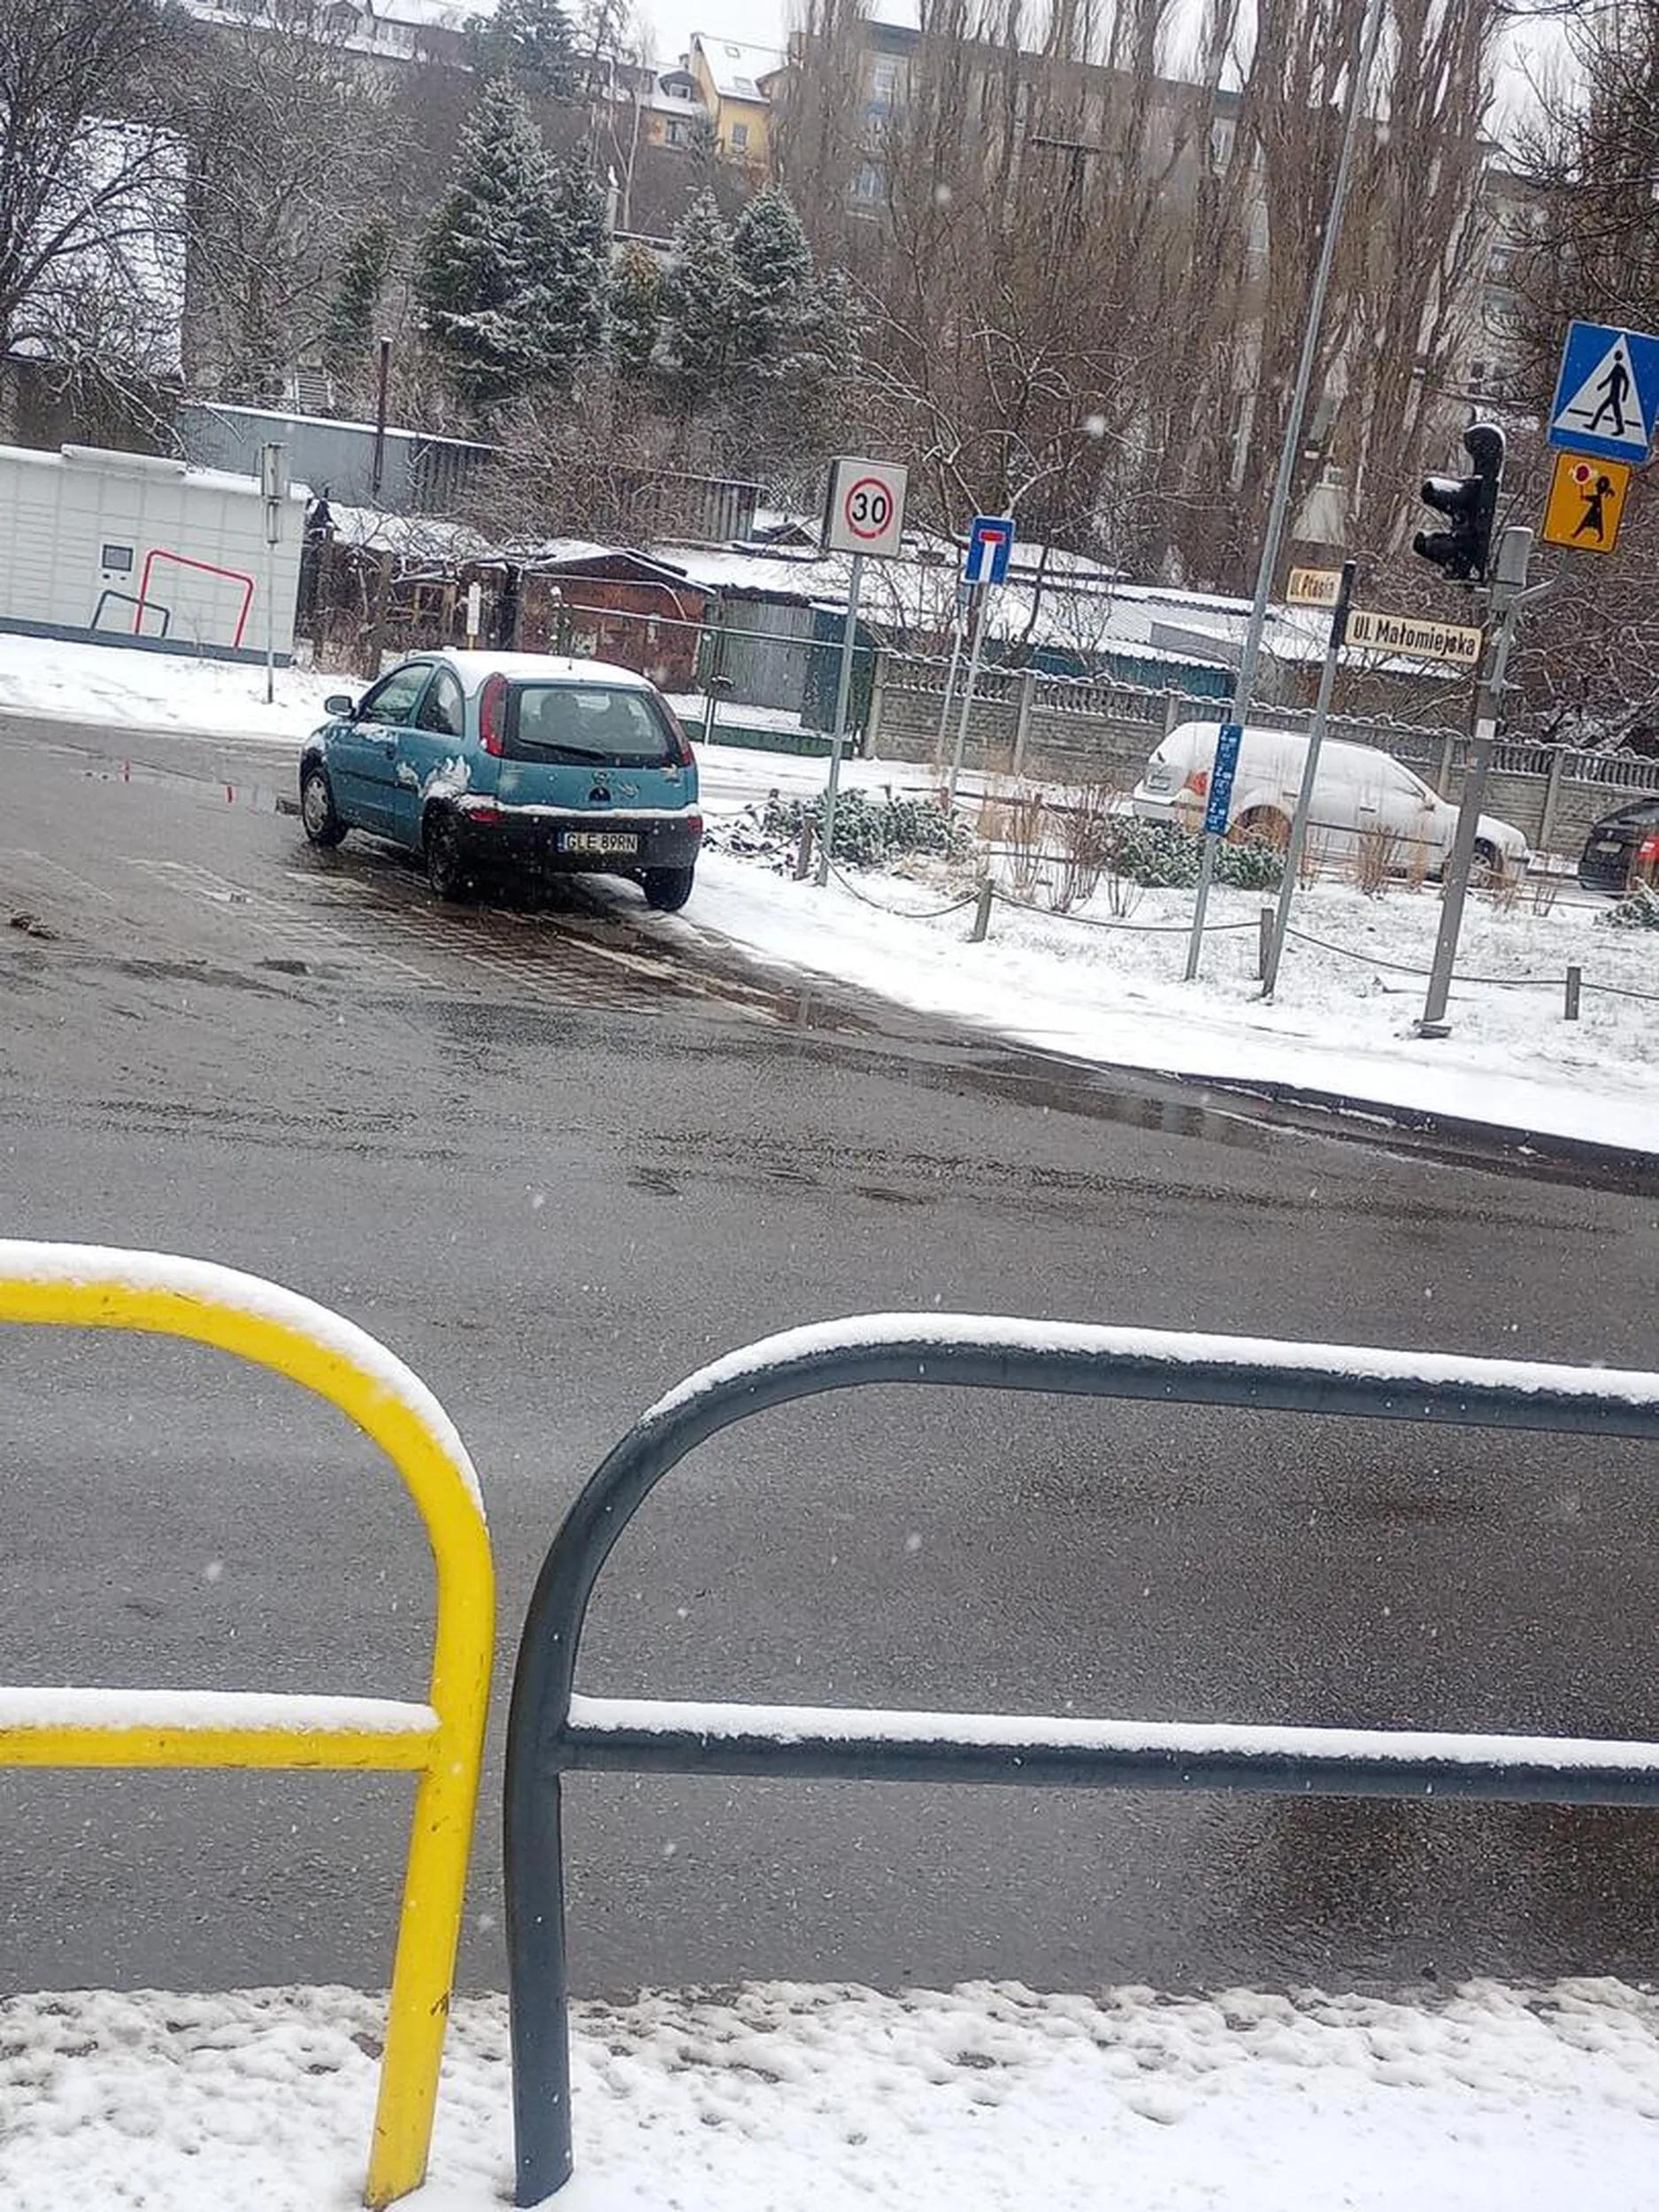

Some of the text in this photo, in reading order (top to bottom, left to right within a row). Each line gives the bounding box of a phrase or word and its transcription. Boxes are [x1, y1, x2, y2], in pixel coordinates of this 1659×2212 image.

[852, 493, 887, 524] 30
[1375, 618, 1476, 656] Małomiejska
[567, 833, 598, 849] GLE
